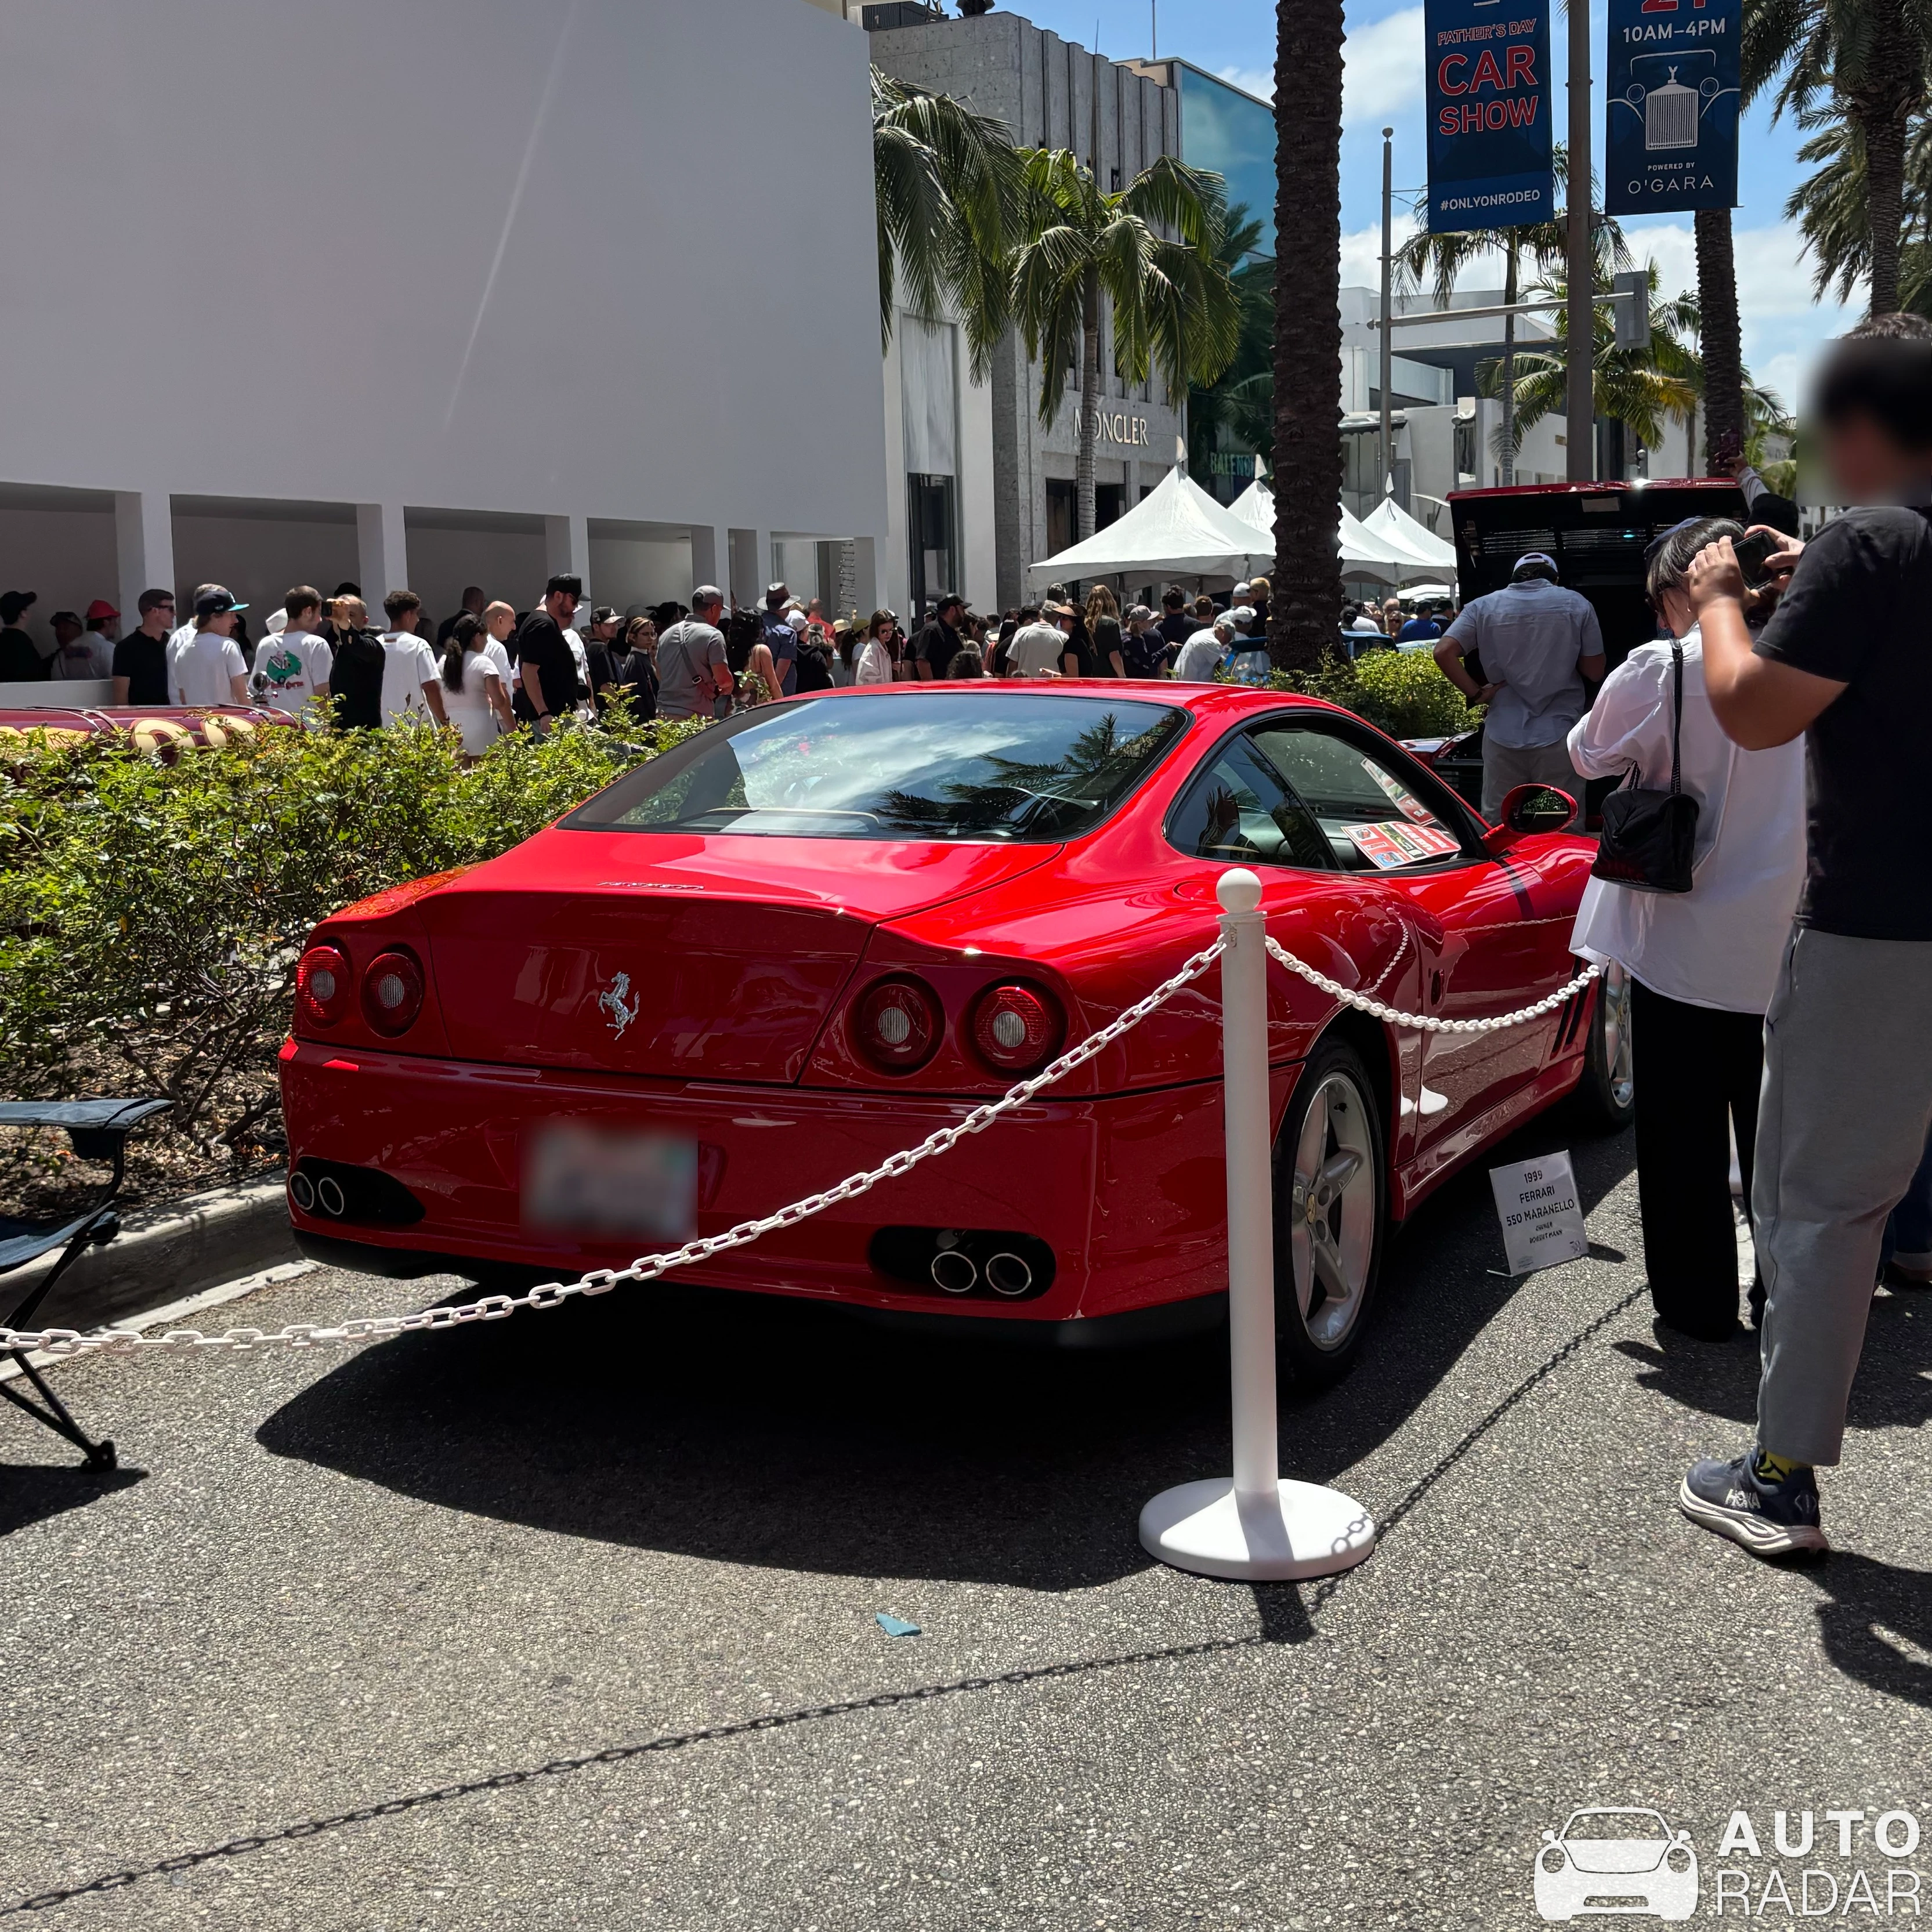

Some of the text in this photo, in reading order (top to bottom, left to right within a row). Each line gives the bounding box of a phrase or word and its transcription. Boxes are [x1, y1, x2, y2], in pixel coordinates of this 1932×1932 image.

[1438, 18, 1537, 46] FATHER'S DAY
[1438, 45, 1539, 96] CAR
[1439, 96, 1539, 136] SHOW
[1648, 162, 1683, 171] POWERED
[1628, 175, 1714, 194] O'GARA
[1440, 189, 1540, 211] #ONLYONRODEO
[1519, 1185, 1555, 1204] FERRARI
[1506, 1198, 1575, 1227] 550 MARANELLO
